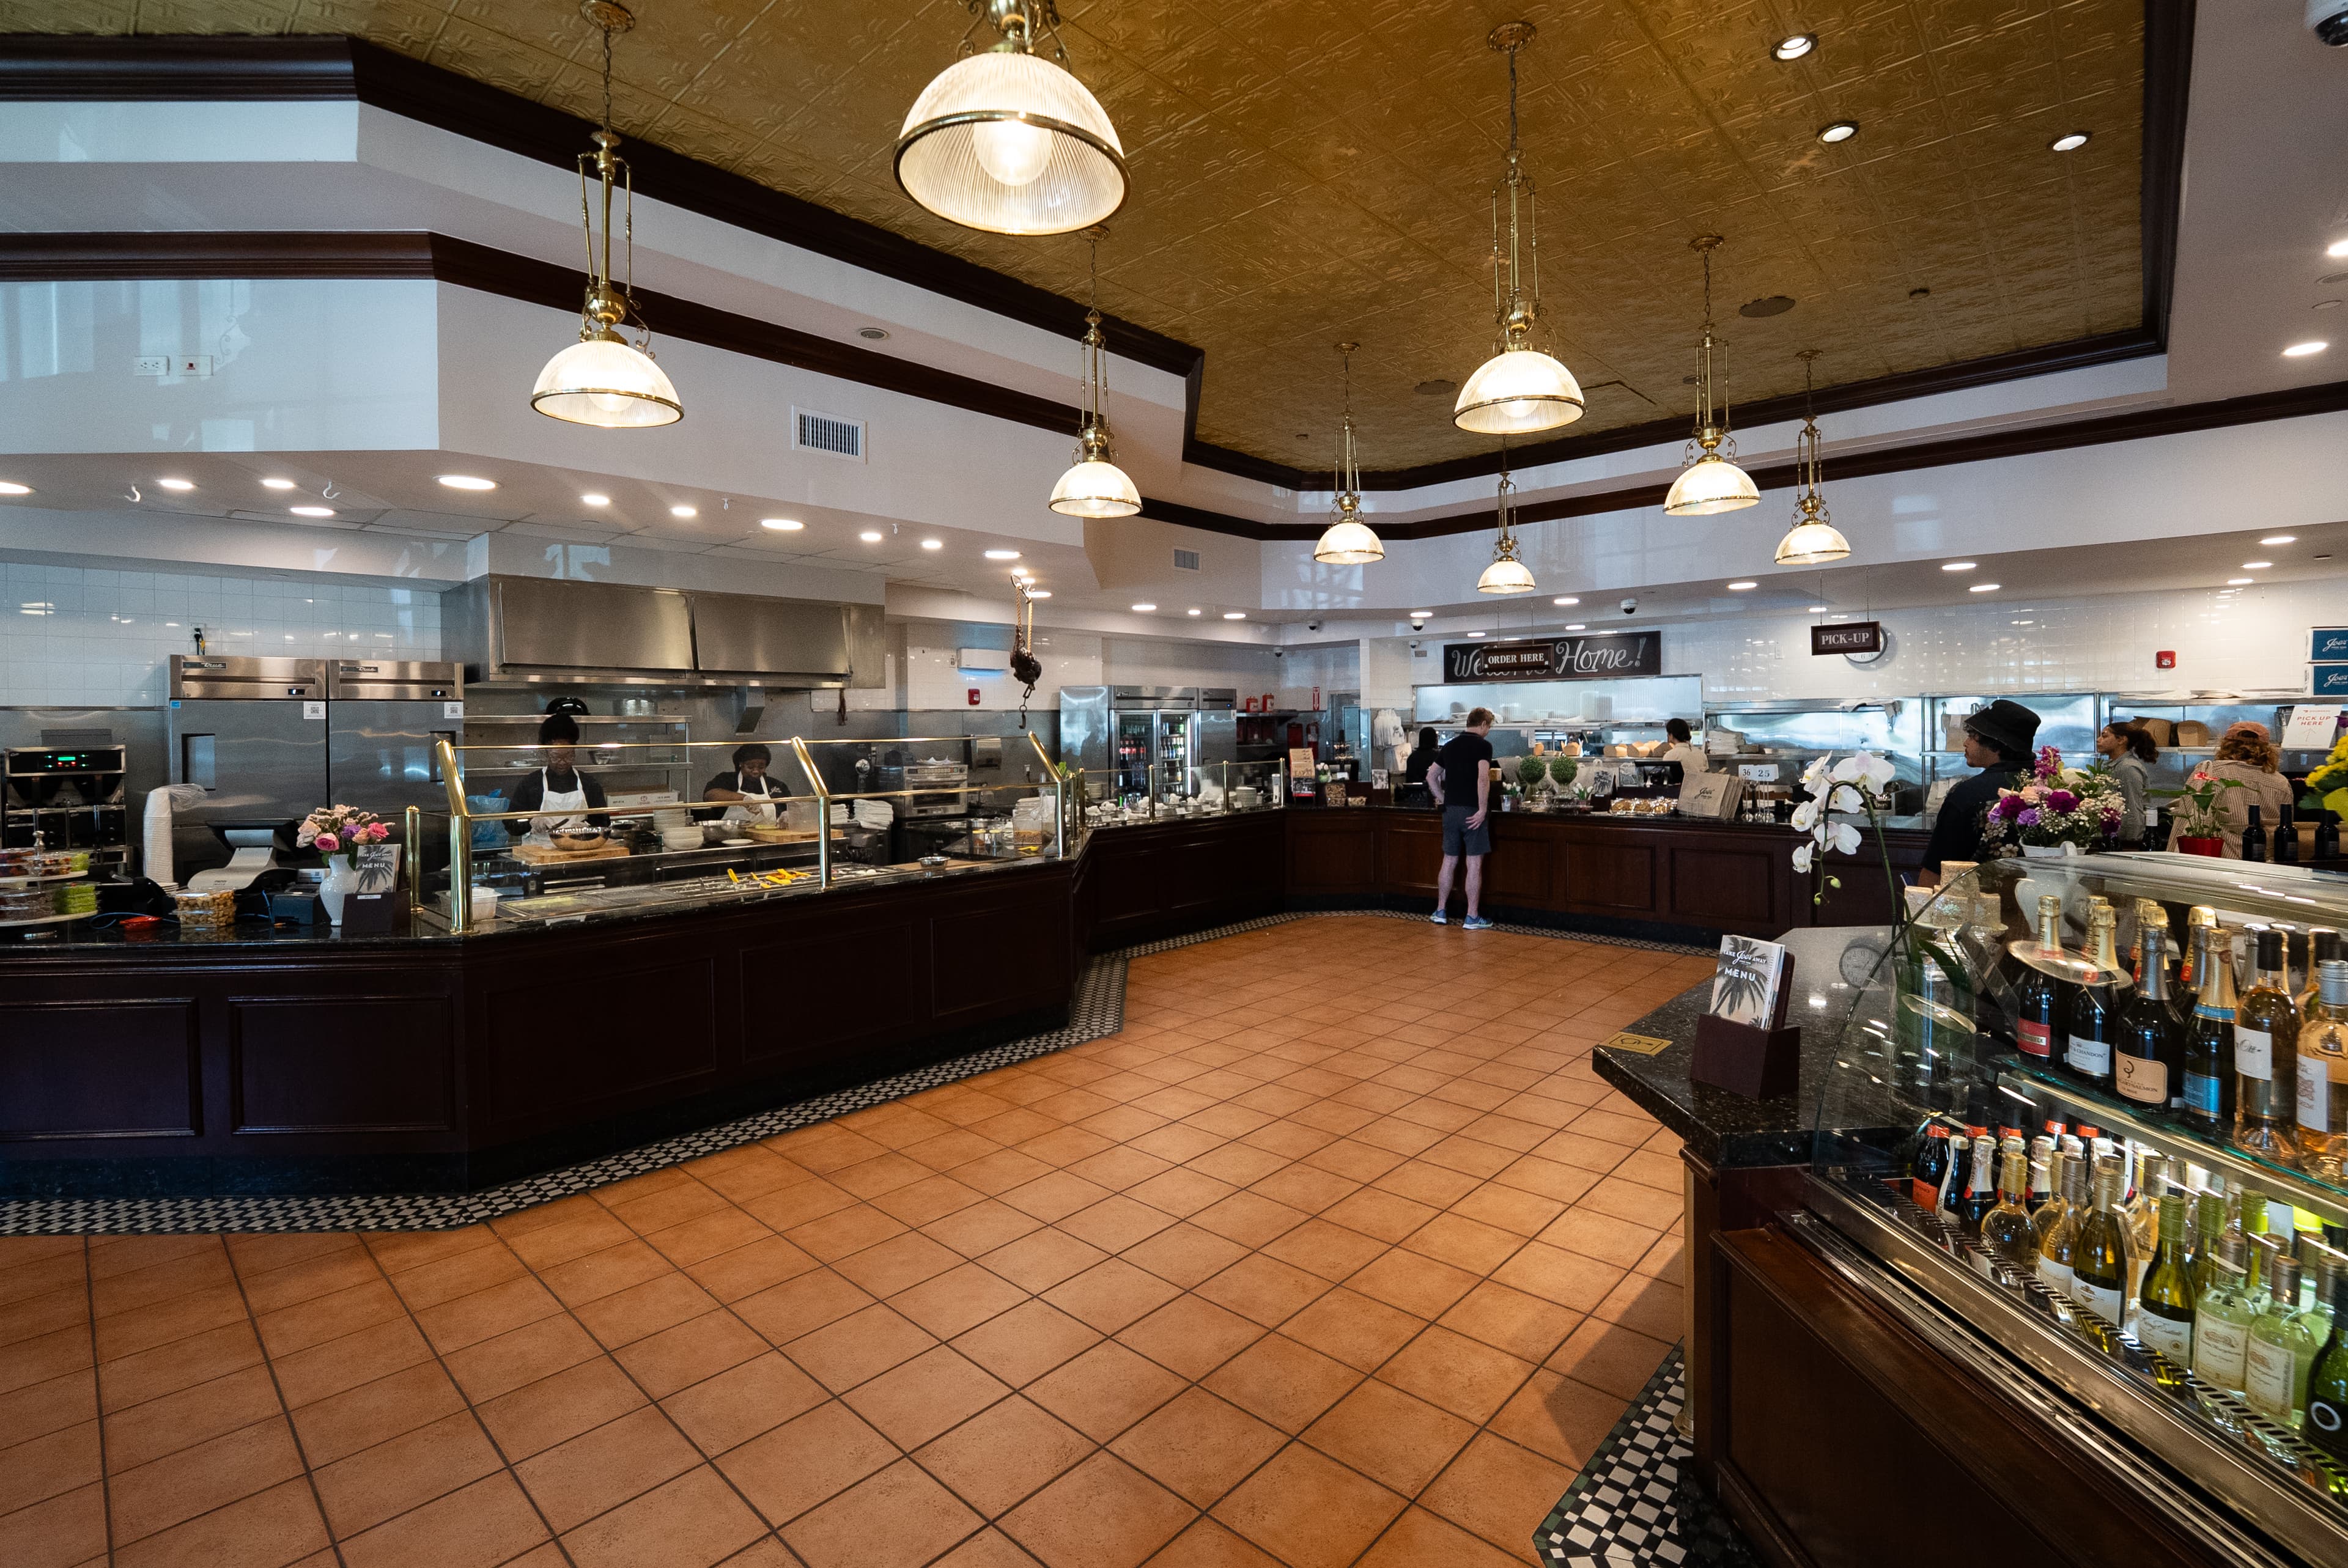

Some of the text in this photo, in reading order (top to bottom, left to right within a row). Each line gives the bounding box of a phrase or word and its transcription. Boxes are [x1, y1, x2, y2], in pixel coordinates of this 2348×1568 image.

[1822, 632, 1869, 645] PICK-UP
[1488, 653, 1545, 664] ORDER HERE
[1556, 637, 1647, 674] Home!
[1724, 966, 1756, 982] MENU
